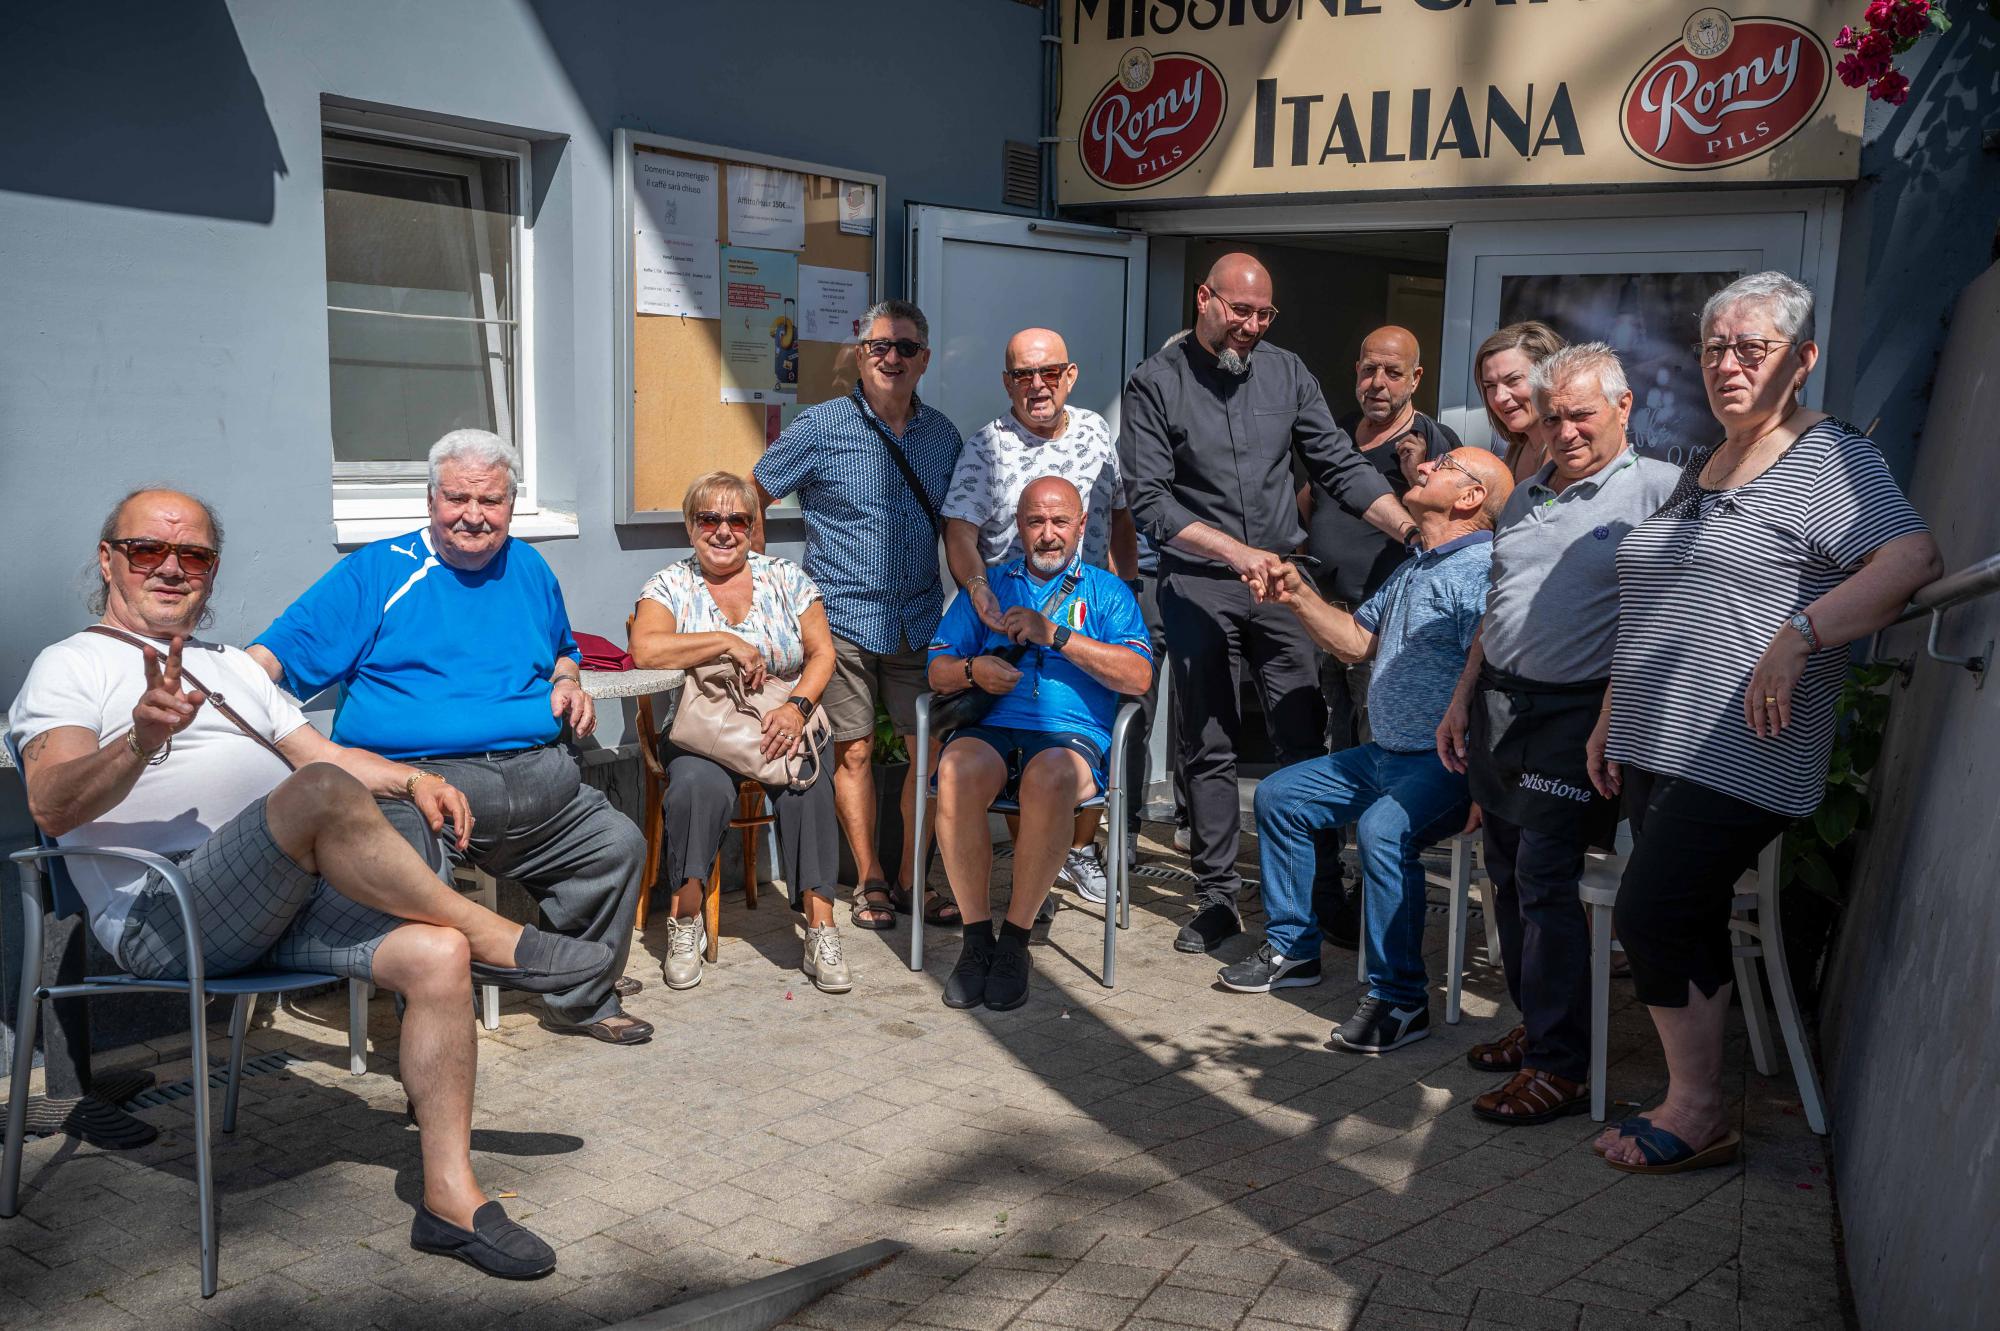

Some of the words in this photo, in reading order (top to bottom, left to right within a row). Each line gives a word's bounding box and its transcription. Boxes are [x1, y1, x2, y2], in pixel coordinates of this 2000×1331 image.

[1641, 37, 1801, 153] Romy
[1091, 69, 1204, 176] Romy
[1254, 78, 1585, 168] ITALIANA
[1706, 121, 1770, 154] PILS
[644, 164, 675, 177] Domenica
[676, 170, 710, 182] pomeriggio
[1137, 145, 1184, 176] PILS
[681, 184, 701, 194] chiuso
[1519, 773, 1592, 803] Missione
